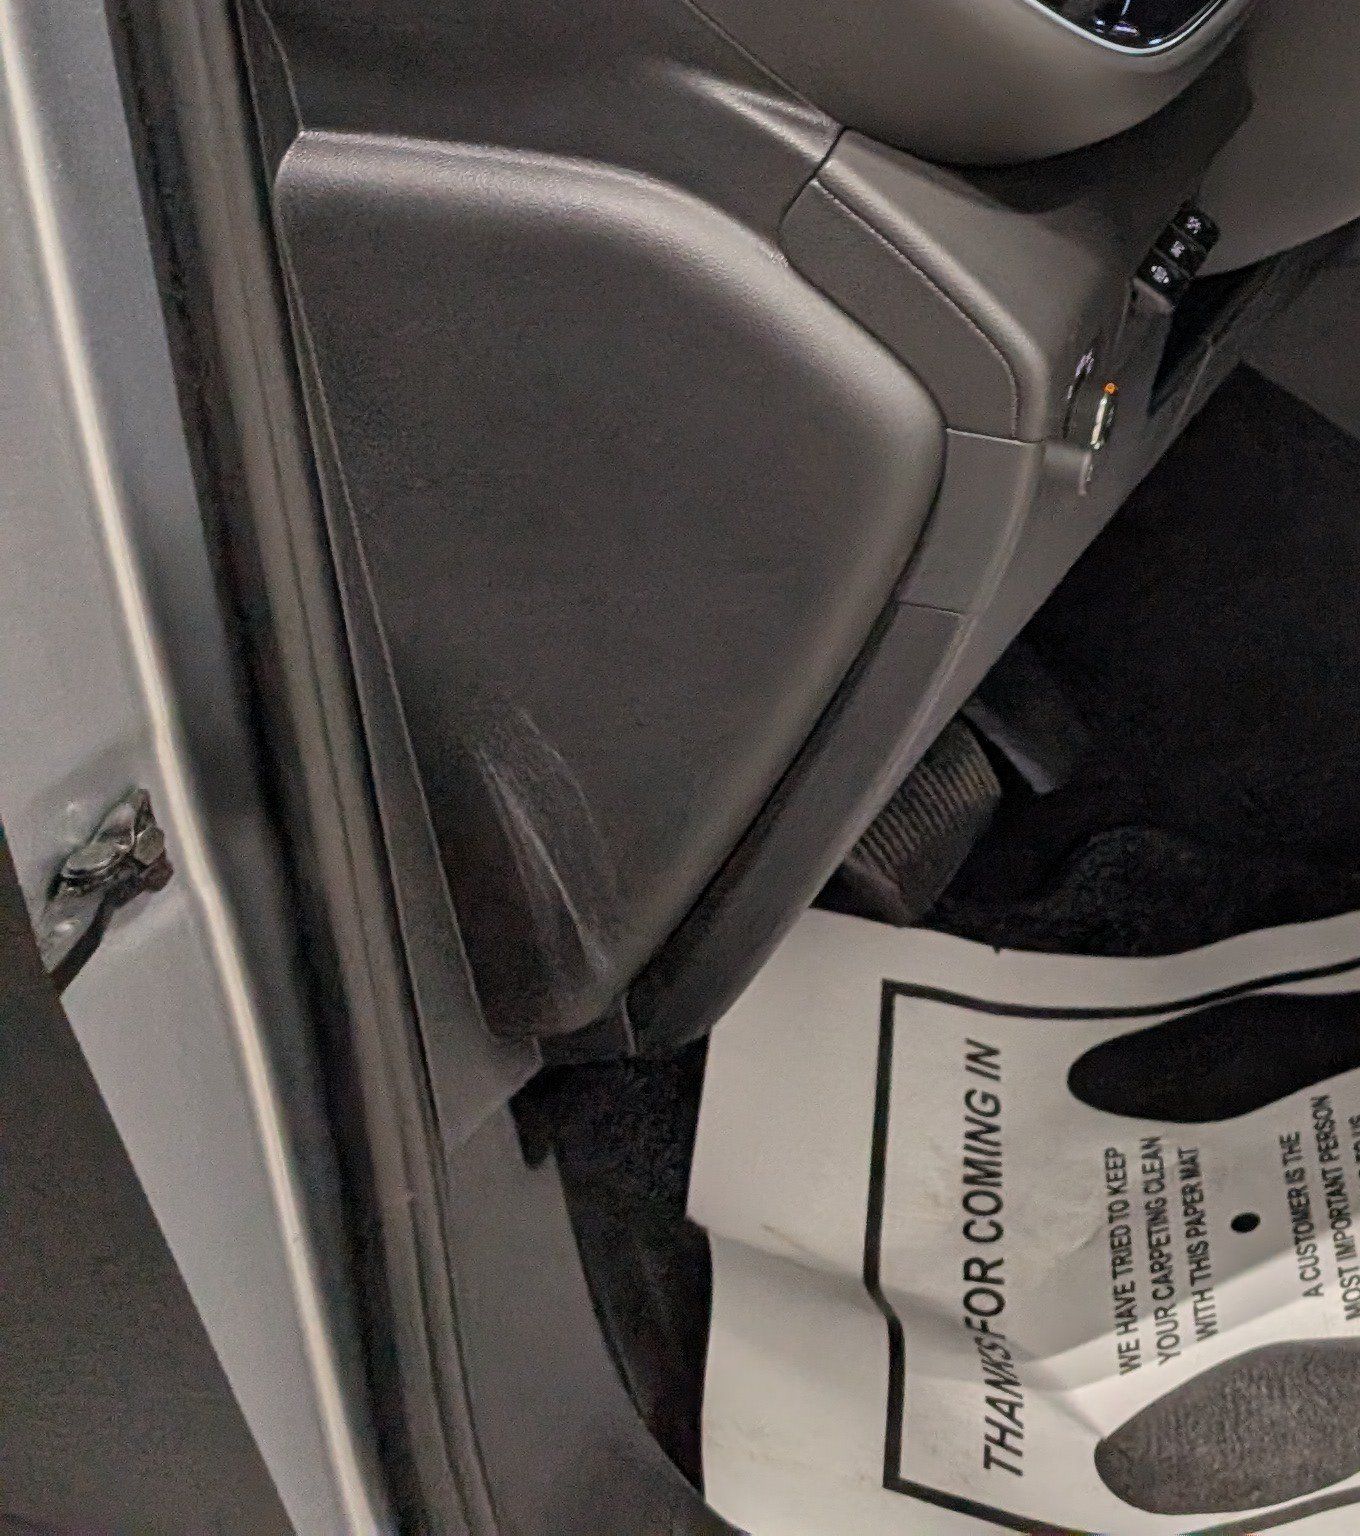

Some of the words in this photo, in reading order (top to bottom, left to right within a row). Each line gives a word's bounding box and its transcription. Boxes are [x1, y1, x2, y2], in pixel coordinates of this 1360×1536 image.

[963, 1037, 1001, 1081] IN
[1279, 1131, 1303, 1166] THE
[1310, 1093, 1340, 1161] PERSON
[962, 1088, 1004, 1242] COMING
[1104, 1146, 1128, 1195] KEEP
[1140, 1135, 1165, 1193] CLEAN
[1178, 1146, 1201, 1179] MAT
[1284, 1167, 1306, 1184] IS
[1108, 1199, 1130, 1223] TO
[1181, 1180, 1207, 1237] PAPER
[1286, 1186, 1321, 1281] CUSTOMER
[1322, 1166, 1358, 1260] IMPORTANT
[1110, 1224, 1133, 1278] TRIED
[1144, 1197, 1174, 1299] CARPETING
[1186, 1240, 1212, 1285] THIS
[962, 1256, 1006, 1336] FOR
[1112, 1280, 1138, 1334] HAVE
[1192, 1286, 1218, 1341] WITH
[1302, 1282, 1324, 1296] A
[1117, 1339, 1142, 1373] WE
[1153, 1303, 1181, 1364] YOUR
[974, 1336, 1024, 1476] THANKS
